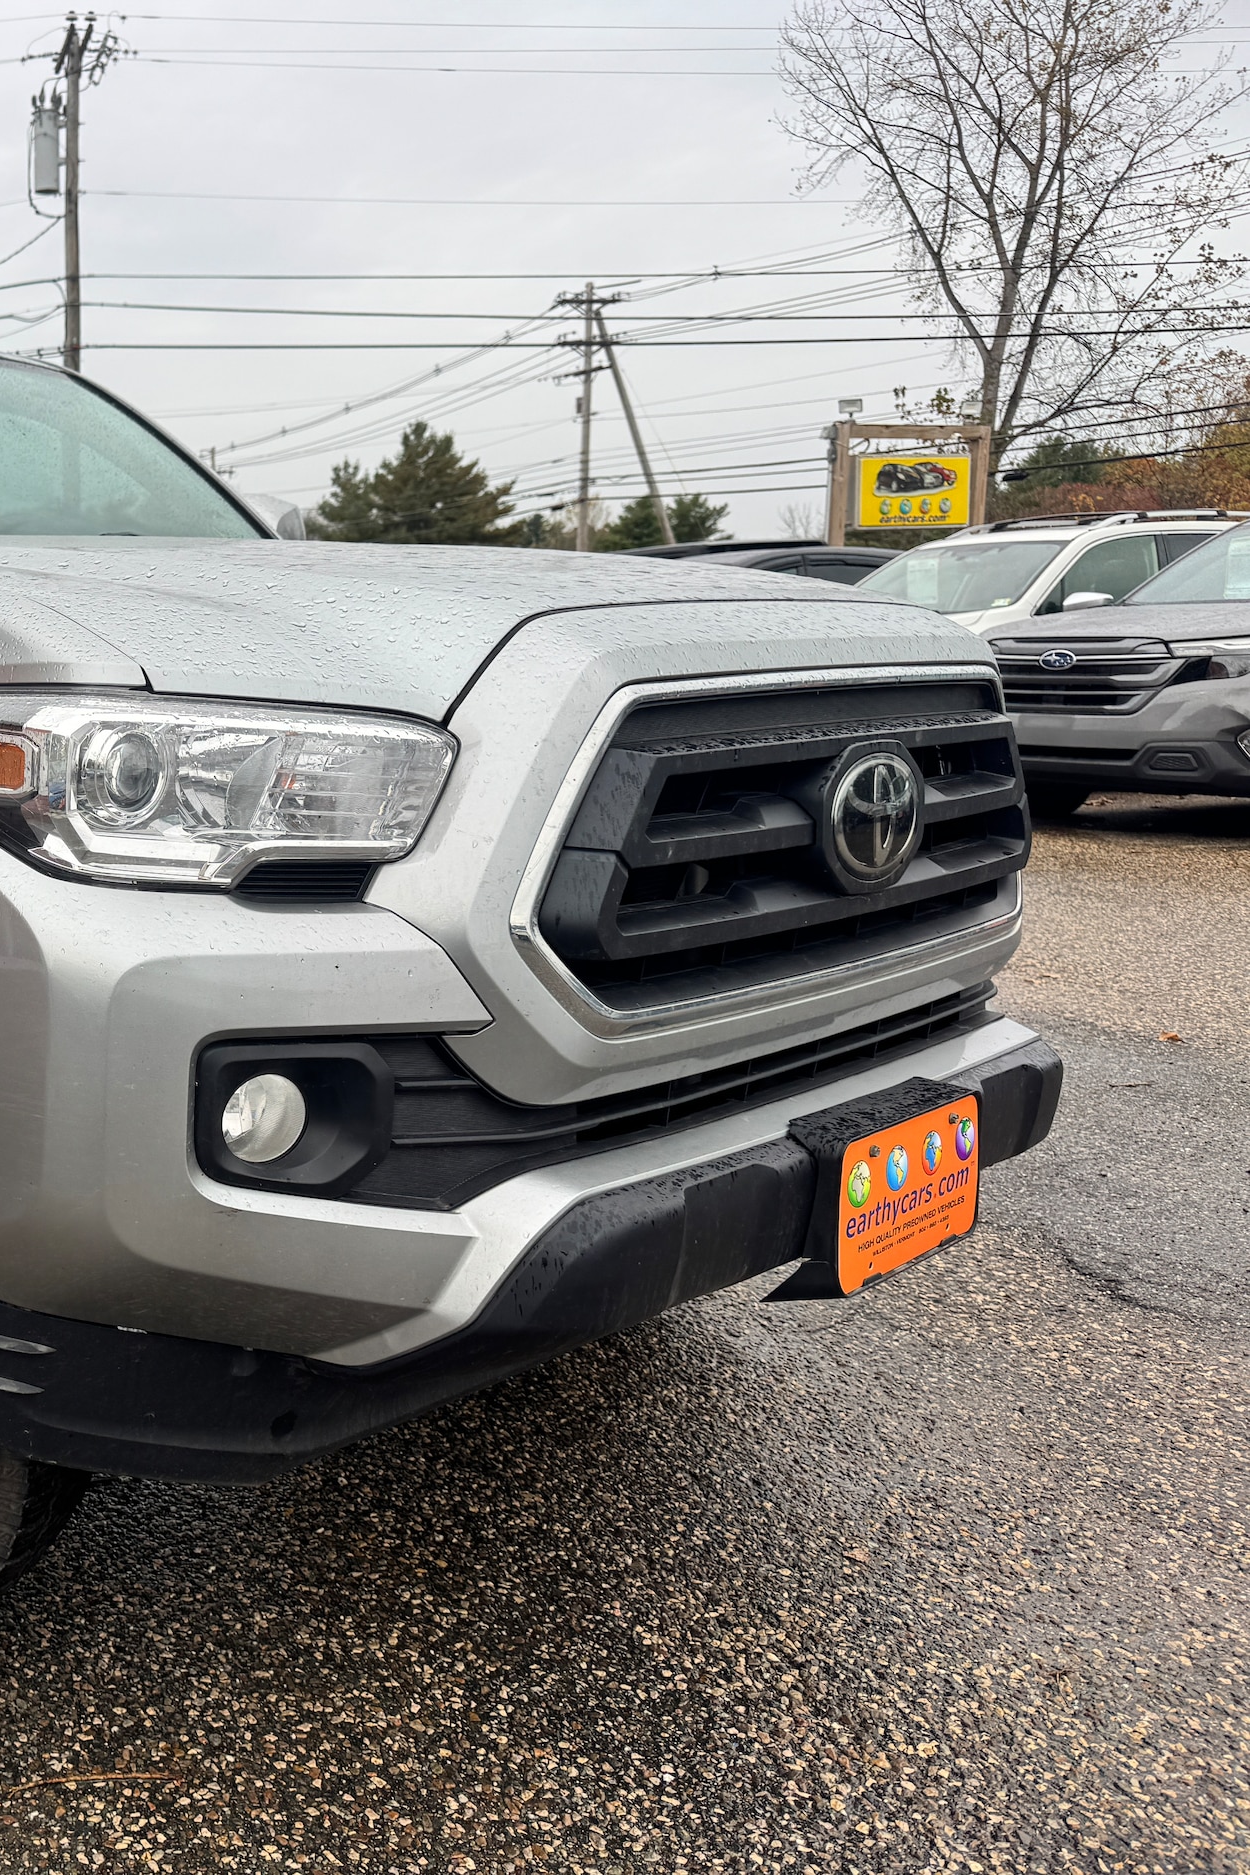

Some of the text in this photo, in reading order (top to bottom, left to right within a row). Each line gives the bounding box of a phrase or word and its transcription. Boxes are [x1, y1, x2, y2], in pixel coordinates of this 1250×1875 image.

[879, 514, 946, 524] earthycars.com
[846, 1166, 969, 1238] earthycars.com
[858, 1195, 965, 1254] HIGH QUALITY PREOWNED VEHICLES
